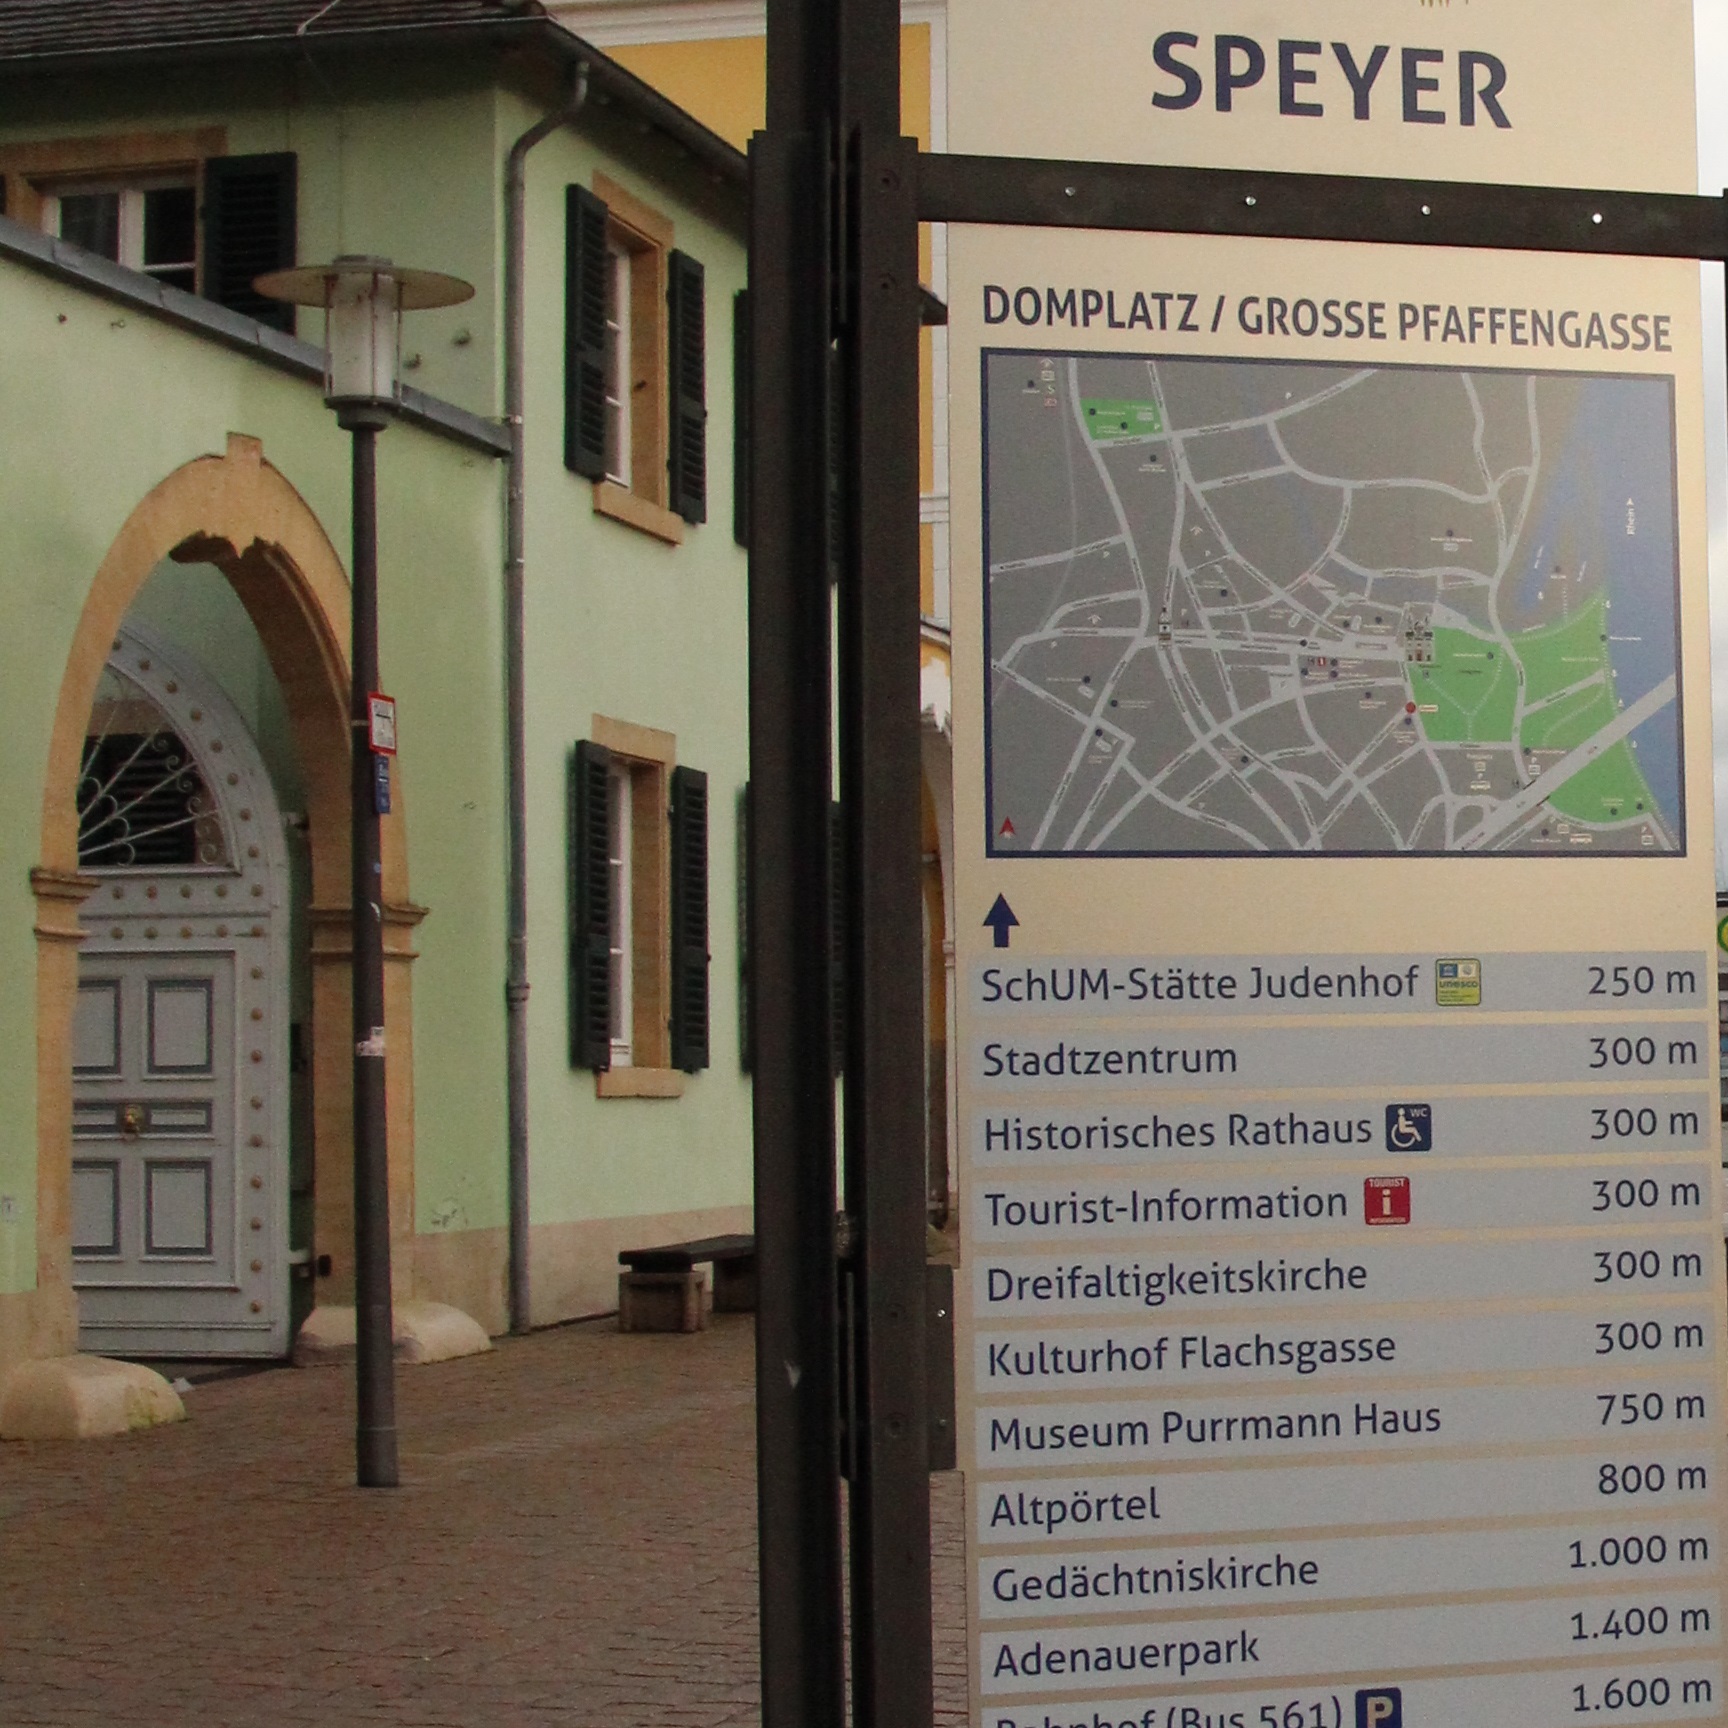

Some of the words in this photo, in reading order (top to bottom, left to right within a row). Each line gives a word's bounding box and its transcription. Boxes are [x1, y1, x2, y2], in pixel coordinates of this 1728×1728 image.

[1151, 31, 1512, 129] SPEYER
[983, 284, 1199, 332] DOMPLATZ
[1210, 295, 1226, 333] /
[1237, 295, 1387, 340] GROSSE
[1398, 302, 1672, 352] PFAFFENGASSE
[982, 967, 1237, 1002] SchUM-Stätte
[1249, 964, 1420, 999] Judenhof
[1588, 966, 1654, 997] 250
[1667, 970, 1696, 994] m
[983, 1042, 1237, 1077] Stadtzentrum
[1589, 1036, 1656, 1069] 300
[1668, 1041, 1697, 1065] m
[1409, 1107, 1429, 1118] WC
[1591, 1108, 1657, 1140] 300
[1669, 1112, 1698, 1135] m
[985, 1114, 1215, 1152] Historisches
[1229, 1112, 1372, 1146] Rathaus
[984, 1186, 1347, 1227] Tourist-Information
[1592, 1179, 1659, 1212] 300
[1671, 1182, 1700, 1206] m
[988, 1257, 1367, 1307] Dreifaltigkeitskirche
[1594, 1250, 1660, 1283] 300
[1673, 1253, 1701, 1277] m
[989, 1337, 1169, 1377] Kulturhof
[1181, 1333, 1396, 1375] Flachsgasse
[1595, 1321, 1662, 1355] 300
[1674, 1324, 1703, 1348] m
[1596, 1392, 1664, 1426] 750
[1676, 1395, 1705, 1419] m
[991, 1418, 1149, 1452] Museum
[1163, 1411, 1341, 1444] Purrmann
[1355, 1402, 1441, 1436] Haus
[1598, 1463, 1665, 1495] 800
[1677, 1466, 1706, 1490] m
[990, 1486, 1161, 1535] Altpörtel
[1569, 1535, 1667, 1568] 1.000
[1679, 1537, 1708, 1561] m
[992, 1553, 1319, 1602] Gedächtniskirche
[1570, 1606, 1668, 1640] 1.400
[1681, 1608, 1710, 1633] m
[993, 1629, 1260, 1678] Adenauerpark
[1573, 1677, 1670, 1712] 1.600
[1683, 1679, 1712, 1704] m
